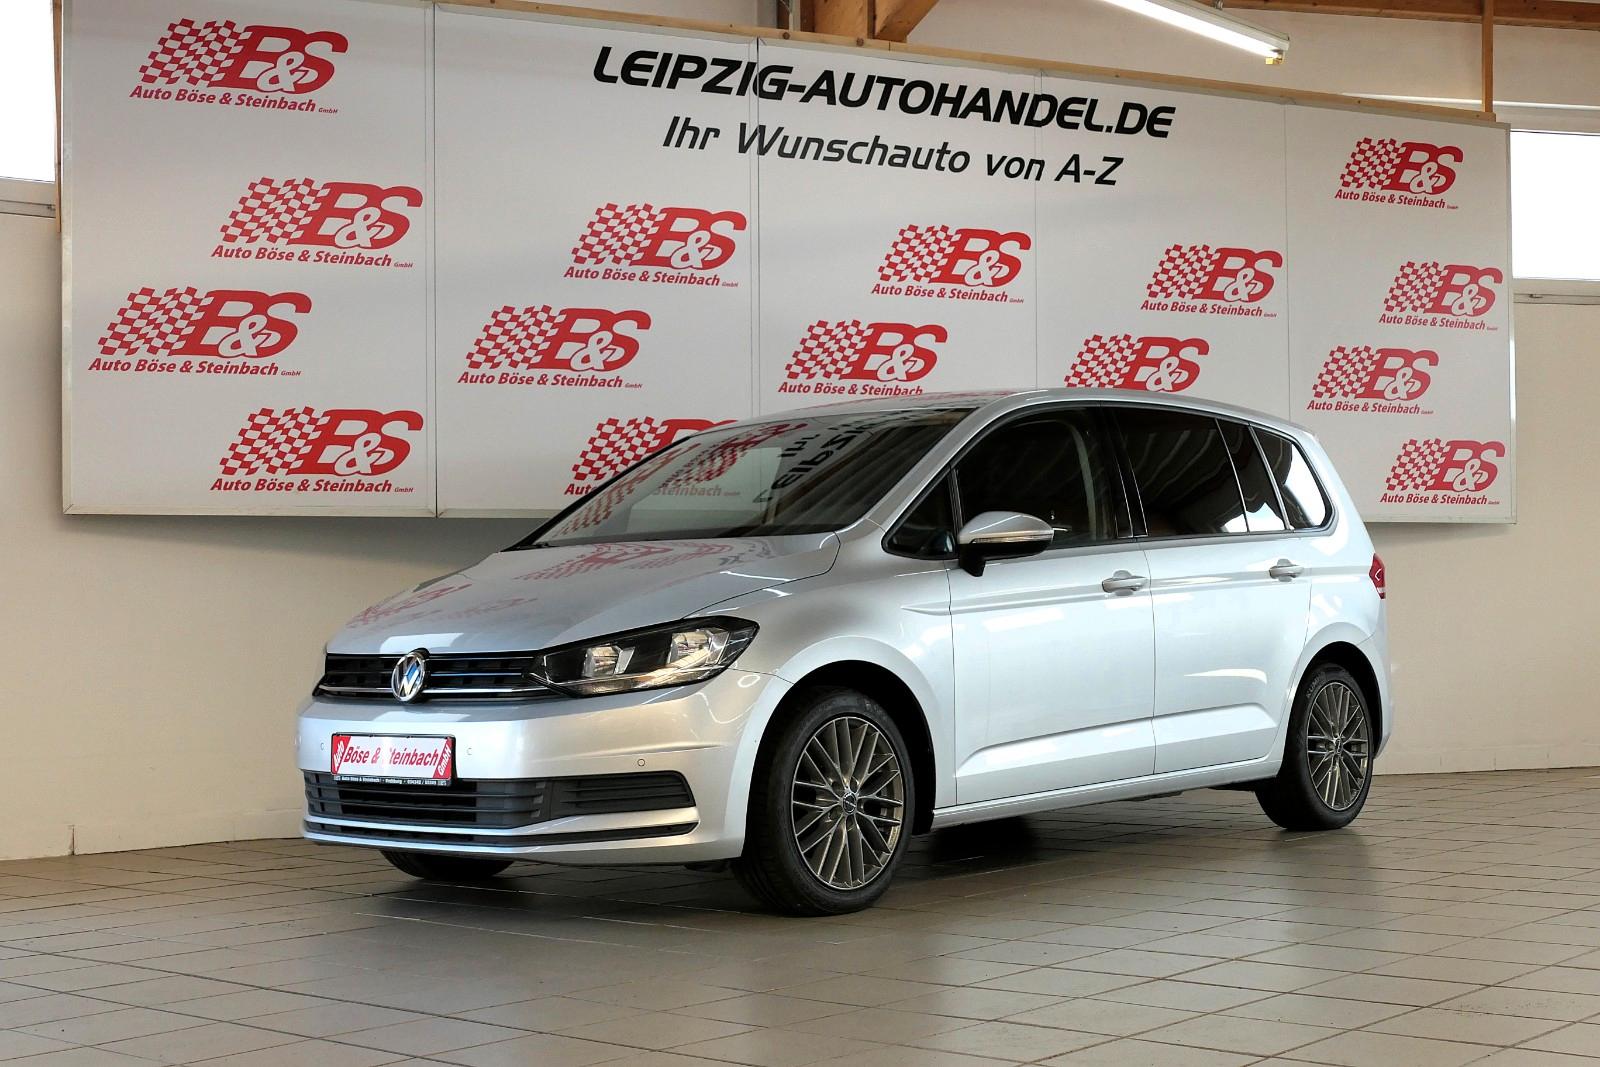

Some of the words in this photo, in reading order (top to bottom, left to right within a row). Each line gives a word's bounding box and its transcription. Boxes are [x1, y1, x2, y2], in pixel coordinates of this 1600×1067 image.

[129, 85, 172, 101] Auto
[175, 89, 216, 104] Böse
[219, 93, 232, 105] &
[234, 94, 316, 113] Steinbach
[318, 107, 338, 115] GmbH
[593, 46, 1176, 138] LEIPZIG-AUTOHANDEL.DE
[662, 116, 720, 150] Ihr
[738, 122, 970, 173] Wunschauto
[986, 153, 1045, 181] von
[1054, 153, 1124, 186] A-Z
[1335, 189, 1360, 200] Auto
[1362, 191, 1386, 203] Böse
[1387, 194, 1396, 204] &
[1397, 195, 1446, 209] Steinbach
[211, 245, 250, 259] Auto
[255, 247, 294, 262] Böse
[298, 249, 310, 262] &
[313, 250, 392, 267] Steinbach
[564, 266, 599, 280] Auto
[602, 268, 637, 281] Böse
[639, 270, 650, 282] &
[652, 271, 720, 287] Steinbach
[871, 284, 902, 296] Auto
[905, 285, 934, 298] Böse
[937, 287, 946, 298] &
[948, 288, 1008, 302] Steinbach
[1140, 300, 1168, 311] Auto
[1170, 301, 1197, 313] Böse
[1199, 303, 1208, 313] &
[1209, 303, 1263, 317] Steinbach
[1379, 313, 1403, 324] Auto
[1405, 315, 1428, 326] Böse
[1430, 317, 1438, 326] &
[1439, 317, 1486, 331] Steinbach
[88, 358, 131, 372] Auto
[134, 359, 175, 373] Böse
[179, 360, 192, 373] &
[195, 361, 278, 376] Steinbach
[457, 372, 495, 385] Auto
[498, 372, 534, 386] Böse
[537, 374, 548, 386] &
[551, 374, 623, 388] Steinbach
[778, 381, 811, 393] Auto
[813, 382, 845, 395] Böse
[847, 384, 858, 395] &
[1307, 400, 1332, 411] Auto
[1335, 401, 1360, 412] Böse
[1361, 402, 1370, 412] &
[1371, 402, 1420, 414] Steinbach
[210, 478, 251, 492] Auto
[254, 478, 294, 492] Böse
[297, 479, 310, 492] &
[312, 478, 392, 493] Steinbach
[1380, 493, 1404, 503] Auto
[1406, 493, 1429, 504] Böse
[1431, 494, 1439, 504] &
[1440, 494, 1487, 505] Steinbach
[344, 746, 369, 764] Böse
[371, 747, 381, 764] &
[386, 747, 439, 766] teinbach
